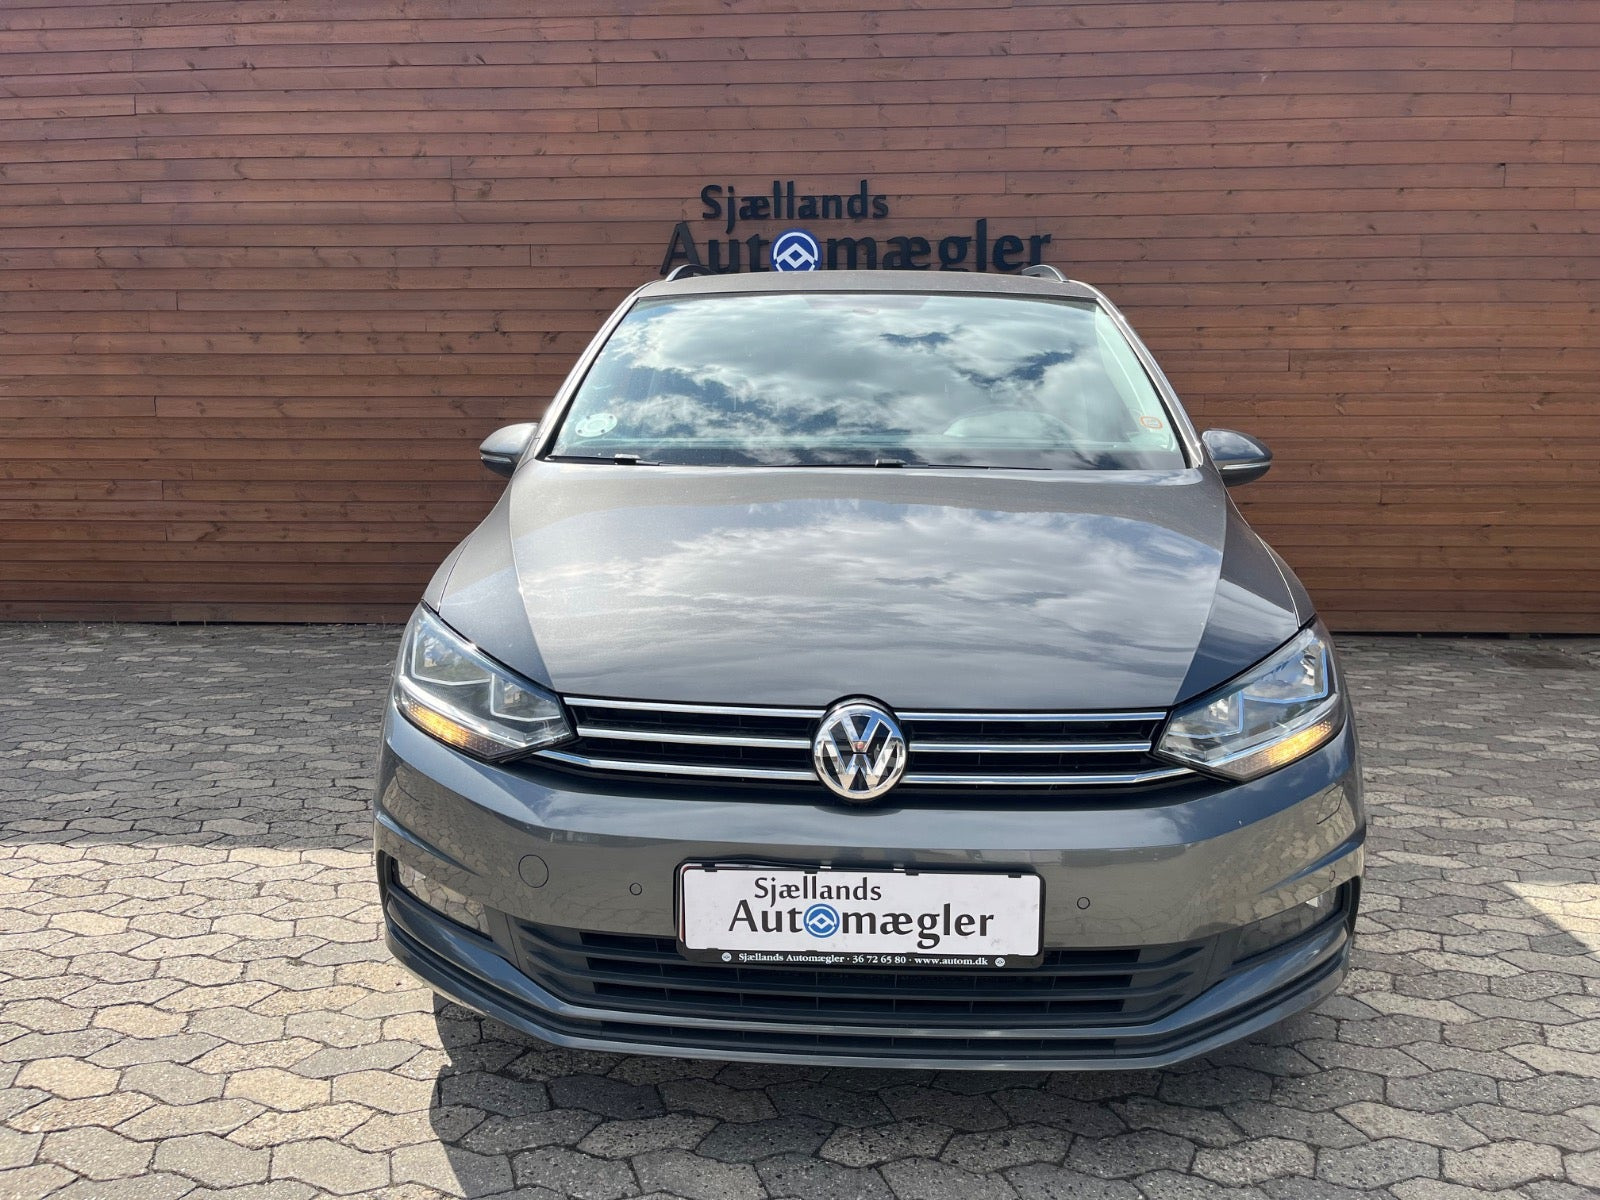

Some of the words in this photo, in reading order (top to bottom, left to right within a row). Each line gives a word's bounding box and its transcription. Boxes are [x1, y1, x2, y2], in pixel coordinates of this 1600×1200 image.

[701, 179, 889, 234] Sjællands
[816, 705, 905, 798] VW
[754, 875, 882, 908] Sjællands
[738, 952, 784, 963] Sjællands
[786, 953, 845, 965] Automægler
[852, 954, 865, 964] 36
[866, 954, 879, 964] 72
[880, 955, 892, 965] 65
[894, 955, 907, 965] 80
[914, 956, 988, 966] www.autom.dk
